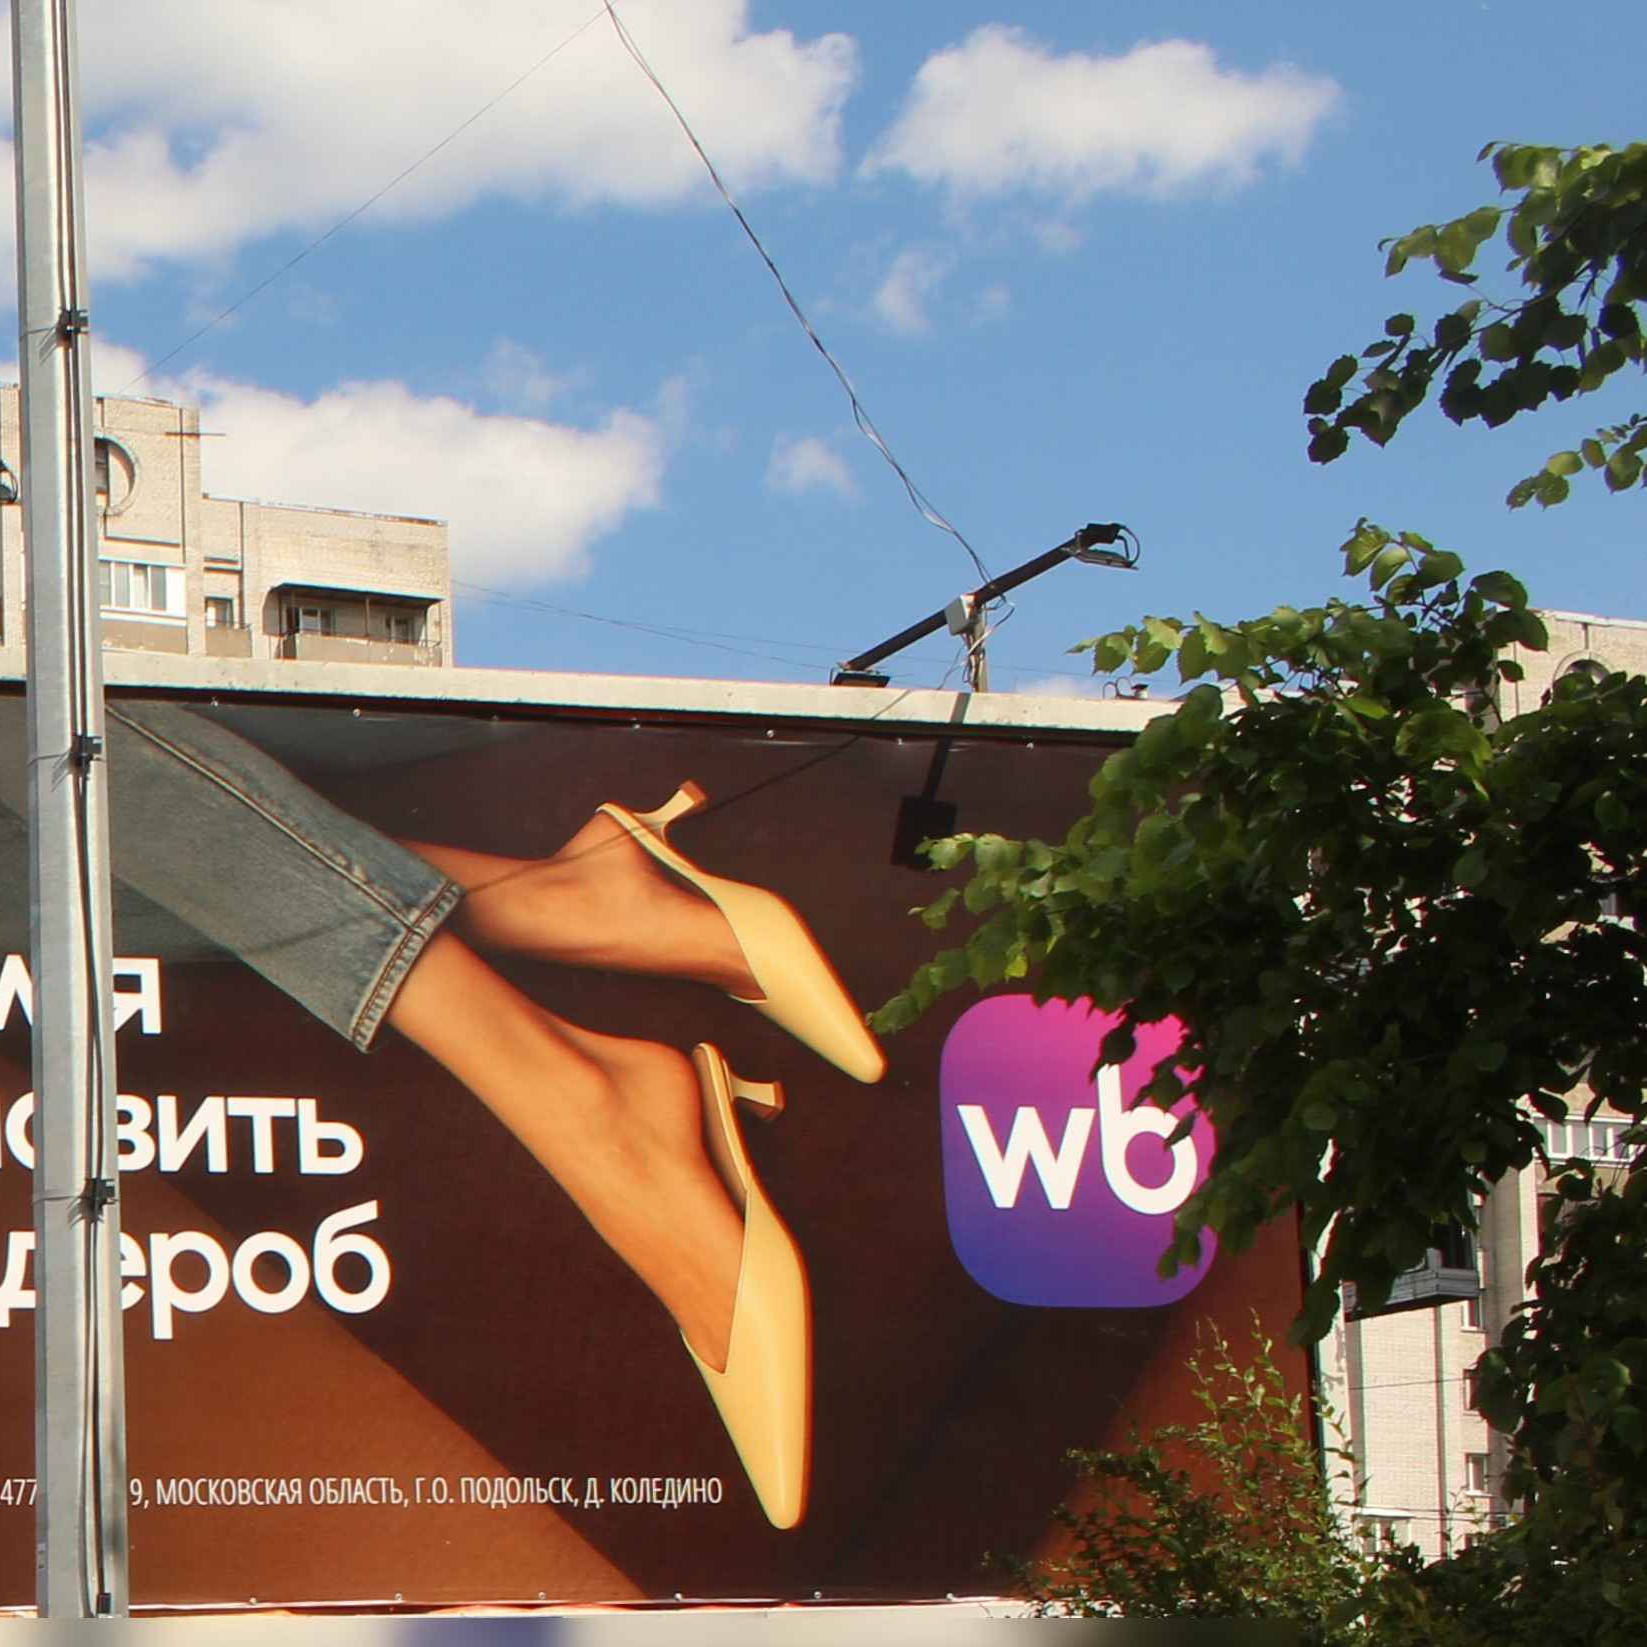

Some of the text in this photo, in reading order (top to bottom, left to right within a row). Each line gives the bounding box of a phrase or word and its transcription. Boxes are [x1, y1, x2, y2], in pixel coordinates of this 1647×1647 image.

[956, 1062, 1198, 1216] wb
[155, 1477, 303, 1506] МОСКОВСКАЯ
[309, 1477, 409, 1508] ОБЛАСТЬ,
[461, 1477, 579, 1509] ПОДОЛЬСК,
[584, 1477, 604, 1508] Д.
[611, 1477, 723, 1508] КОЛЕДИНО
